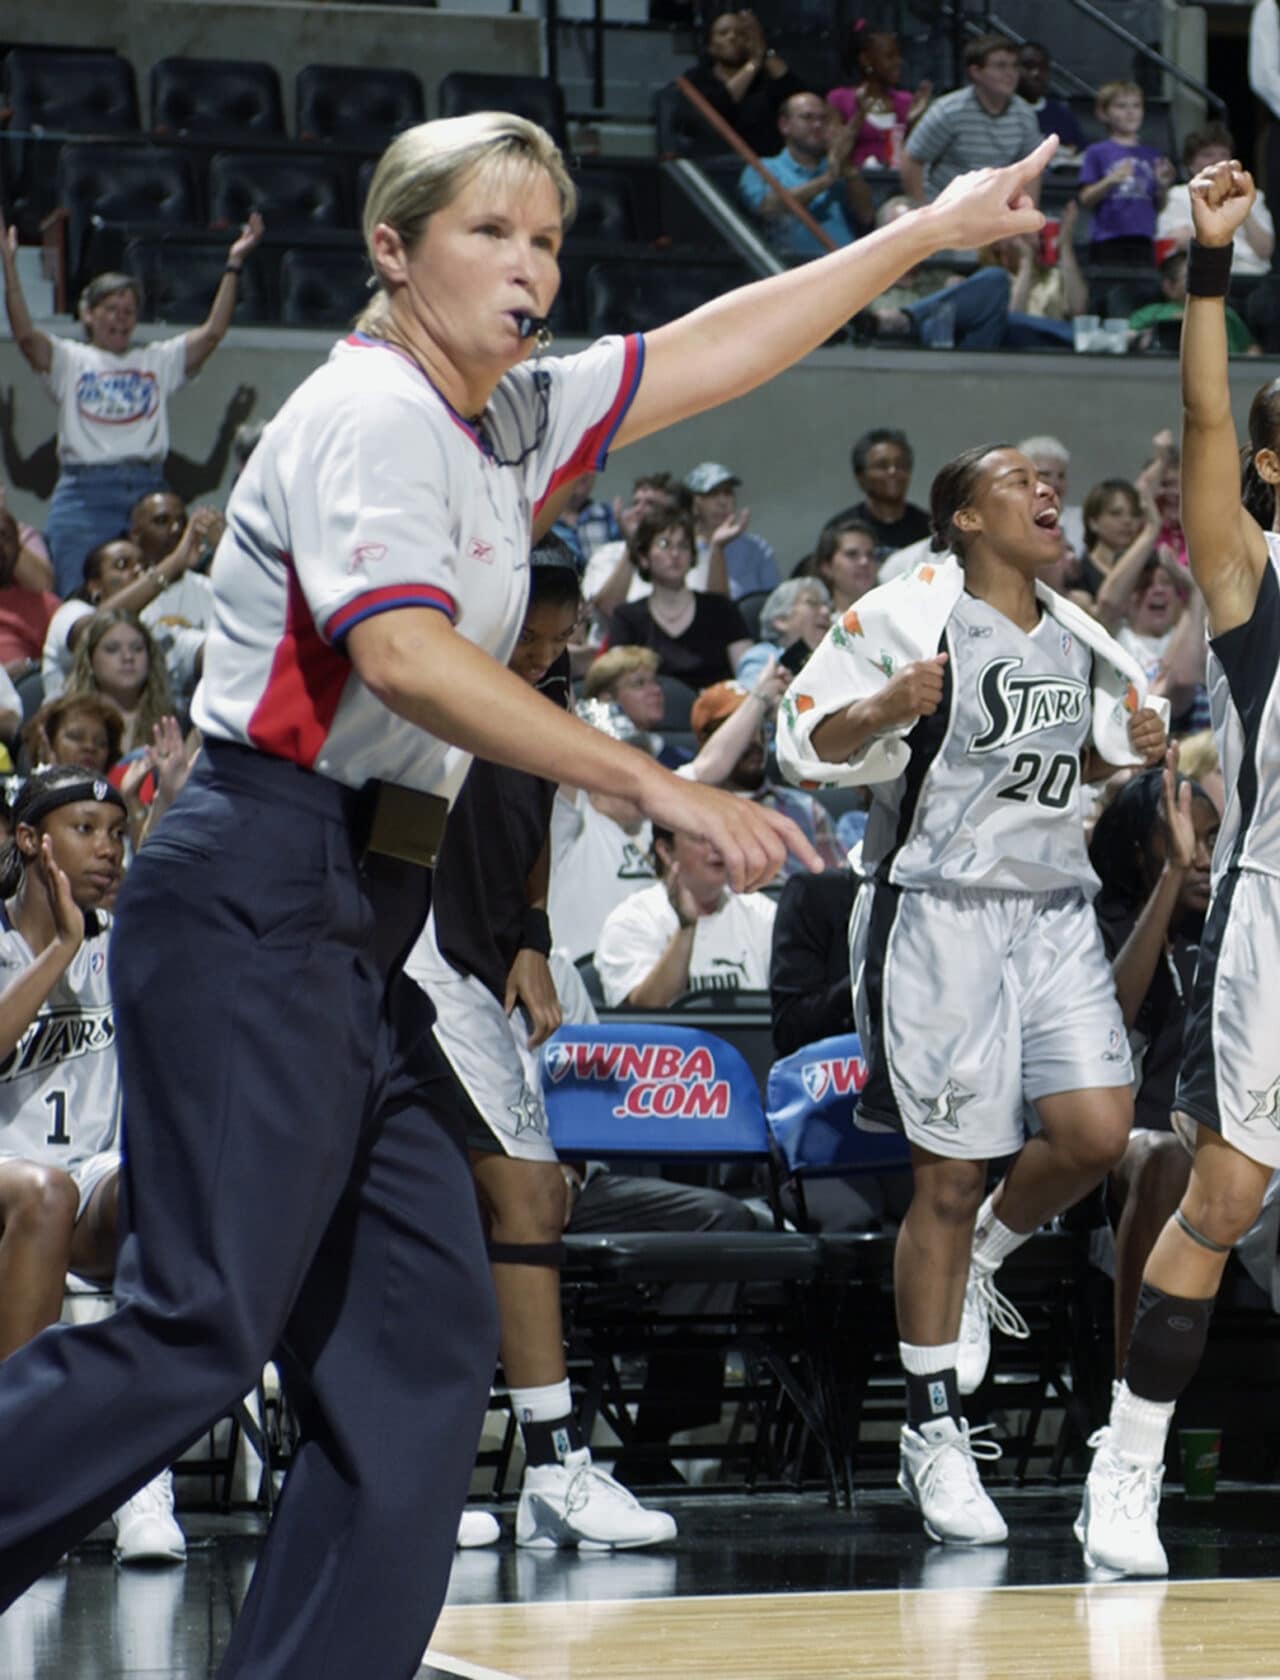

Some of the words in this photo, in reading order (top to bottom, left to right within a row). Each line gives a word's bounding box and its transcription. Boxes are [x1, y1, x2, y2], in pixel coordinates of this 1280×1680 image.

[966, 656, 1088, 754] STARS
[996, 752, 1079, 809] 20
[0, 1004, 115, 1083] TARS
[573, 1042, 714, 1082] WNBA
[44, 1088, 71, 1146] 1
[612, 1080, 730, 1119] .COM
